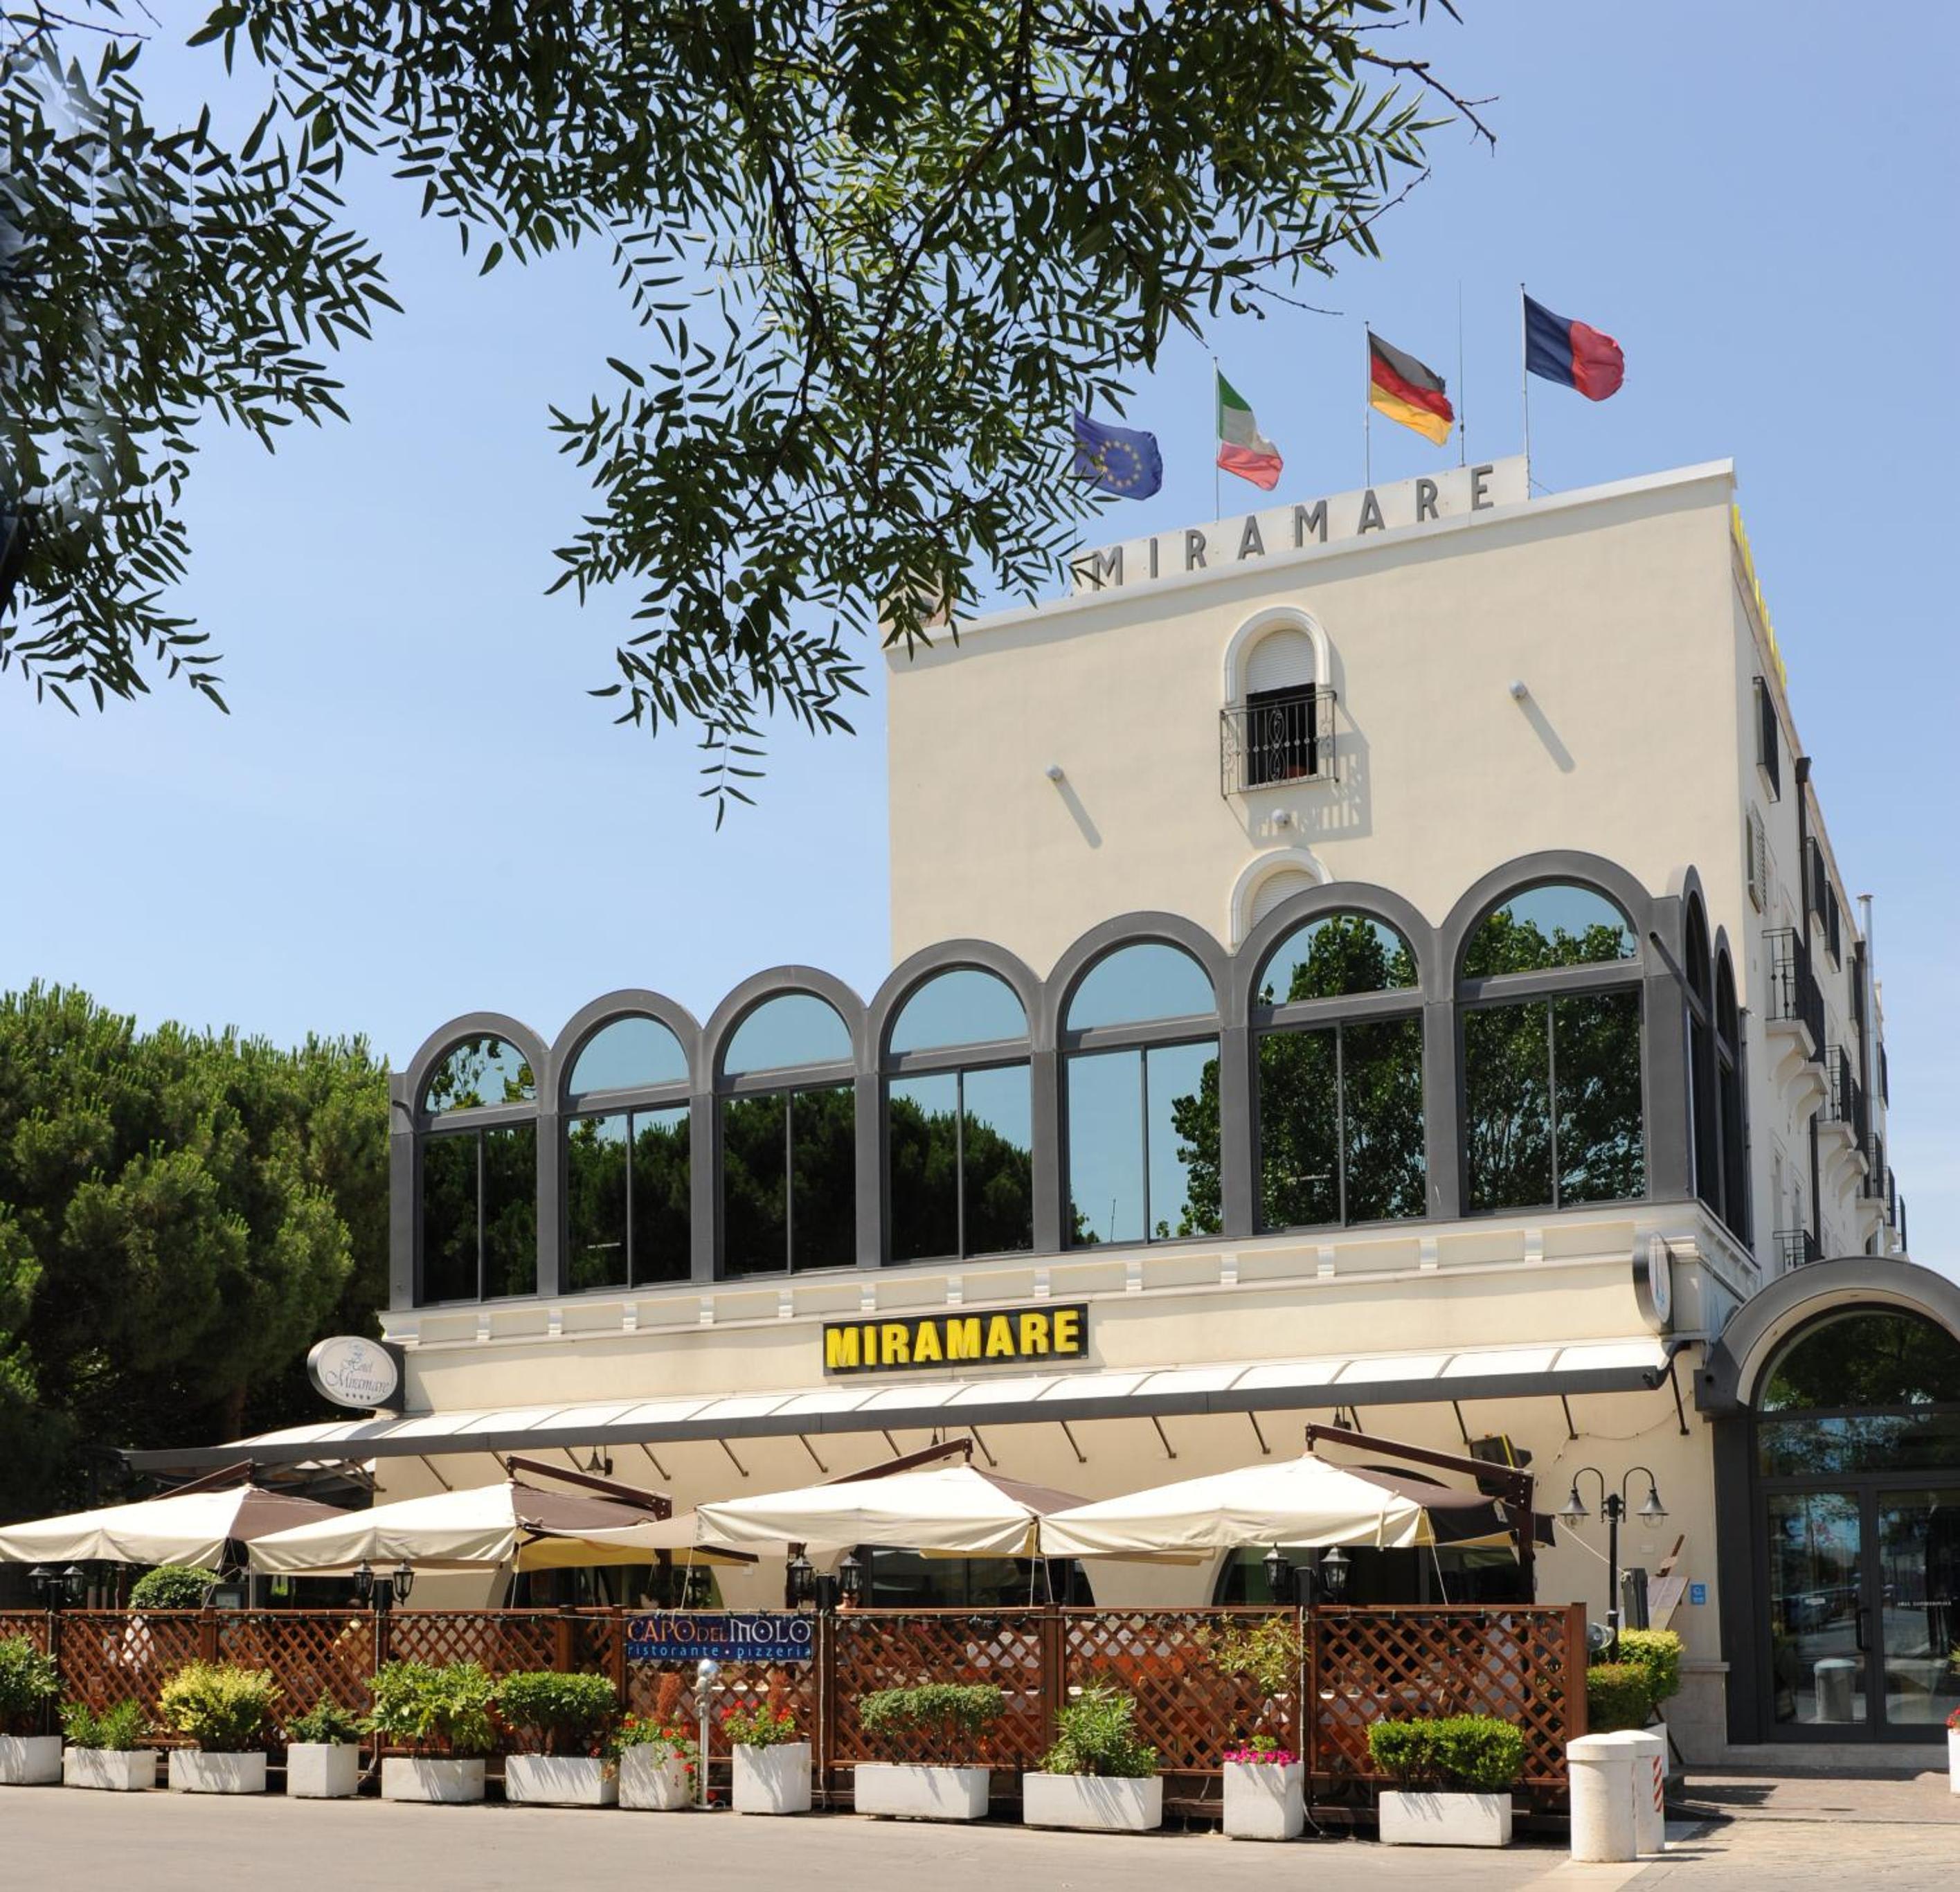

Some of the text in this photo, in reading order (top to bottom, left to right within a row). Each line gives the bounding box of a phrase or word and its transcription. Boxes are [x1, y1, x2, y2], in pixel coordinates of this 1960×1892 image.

[1092, 465, 1494, 591] MIRAMARE
[826, 1310, 1079, 1369] MIRAMARE
[627, 1618, 811, 1643] CAPO DEL MOLO
[627, 1645, 811, 1659] ristorante pizzeria
